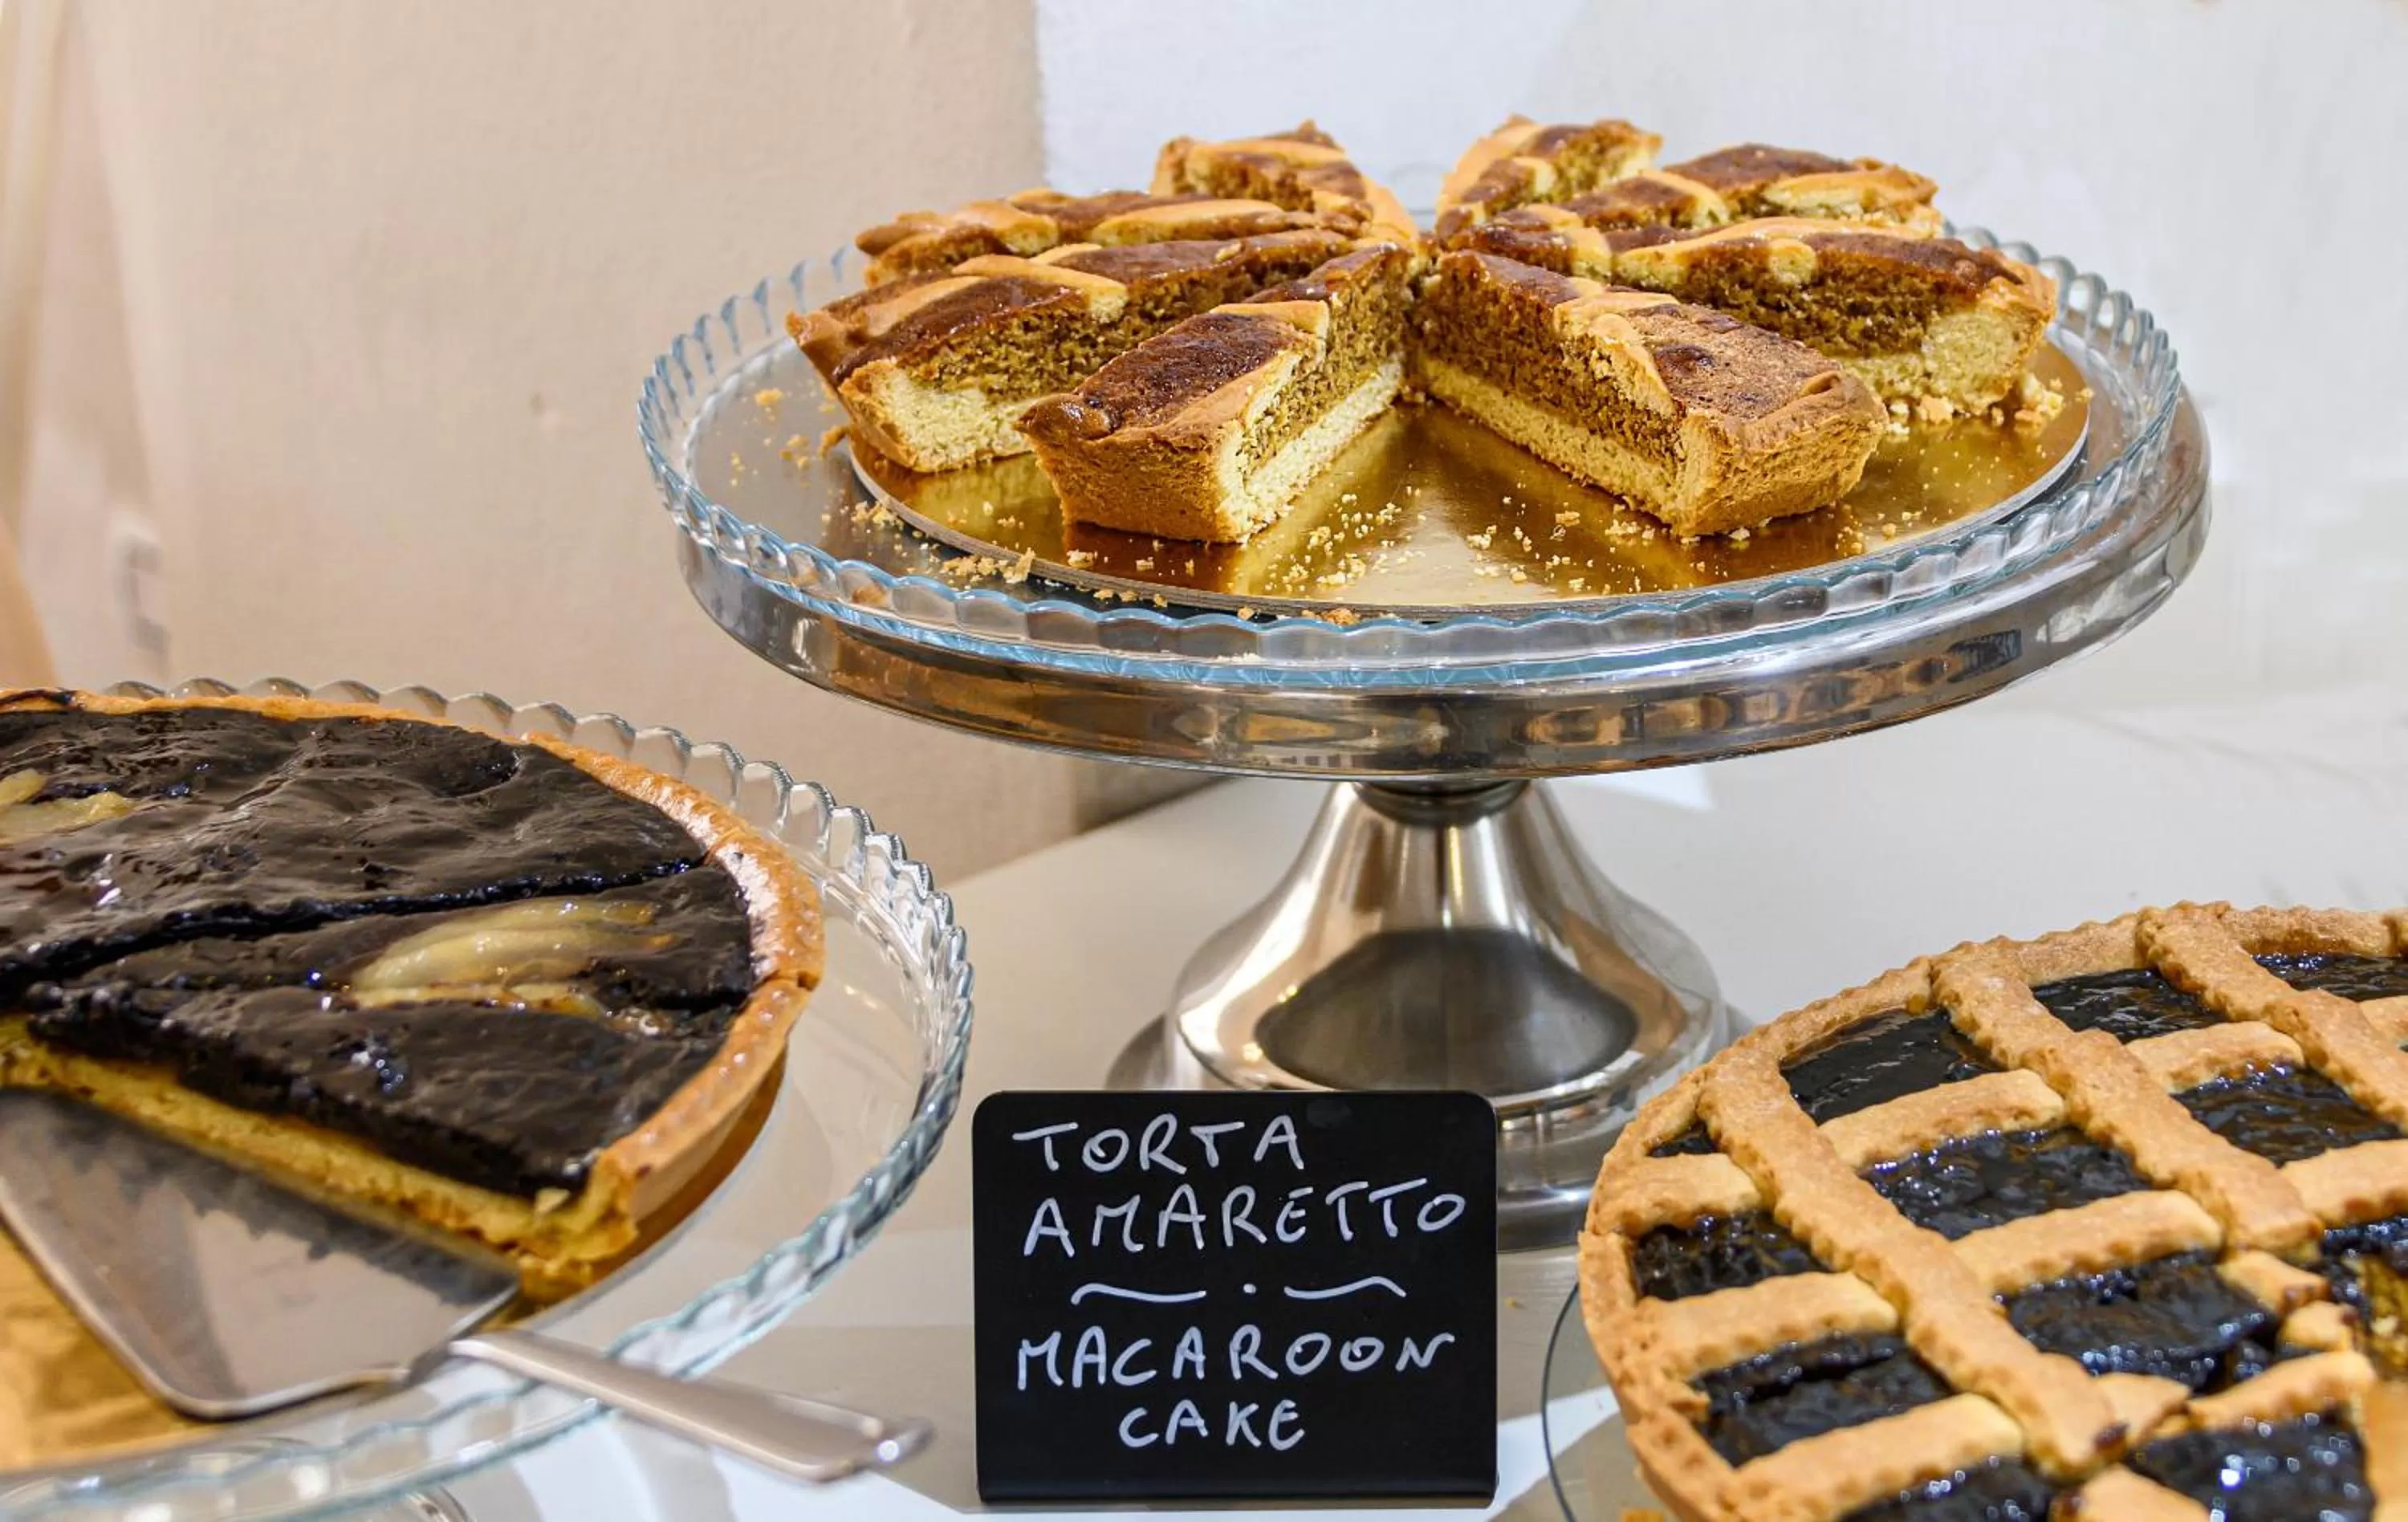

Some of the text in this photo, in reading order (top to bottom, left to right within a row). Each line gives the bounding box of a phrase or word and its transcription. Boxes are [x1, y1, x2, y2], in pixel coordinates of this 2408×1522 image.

[1012, 1113, 1304, 1174] TORTA
[1023, 1178, 1465, 1257] AMARETTO
[1018, 1325, 1455, 1390] MACAROON
[1119, 1399, 1306, 1451] CAKE
